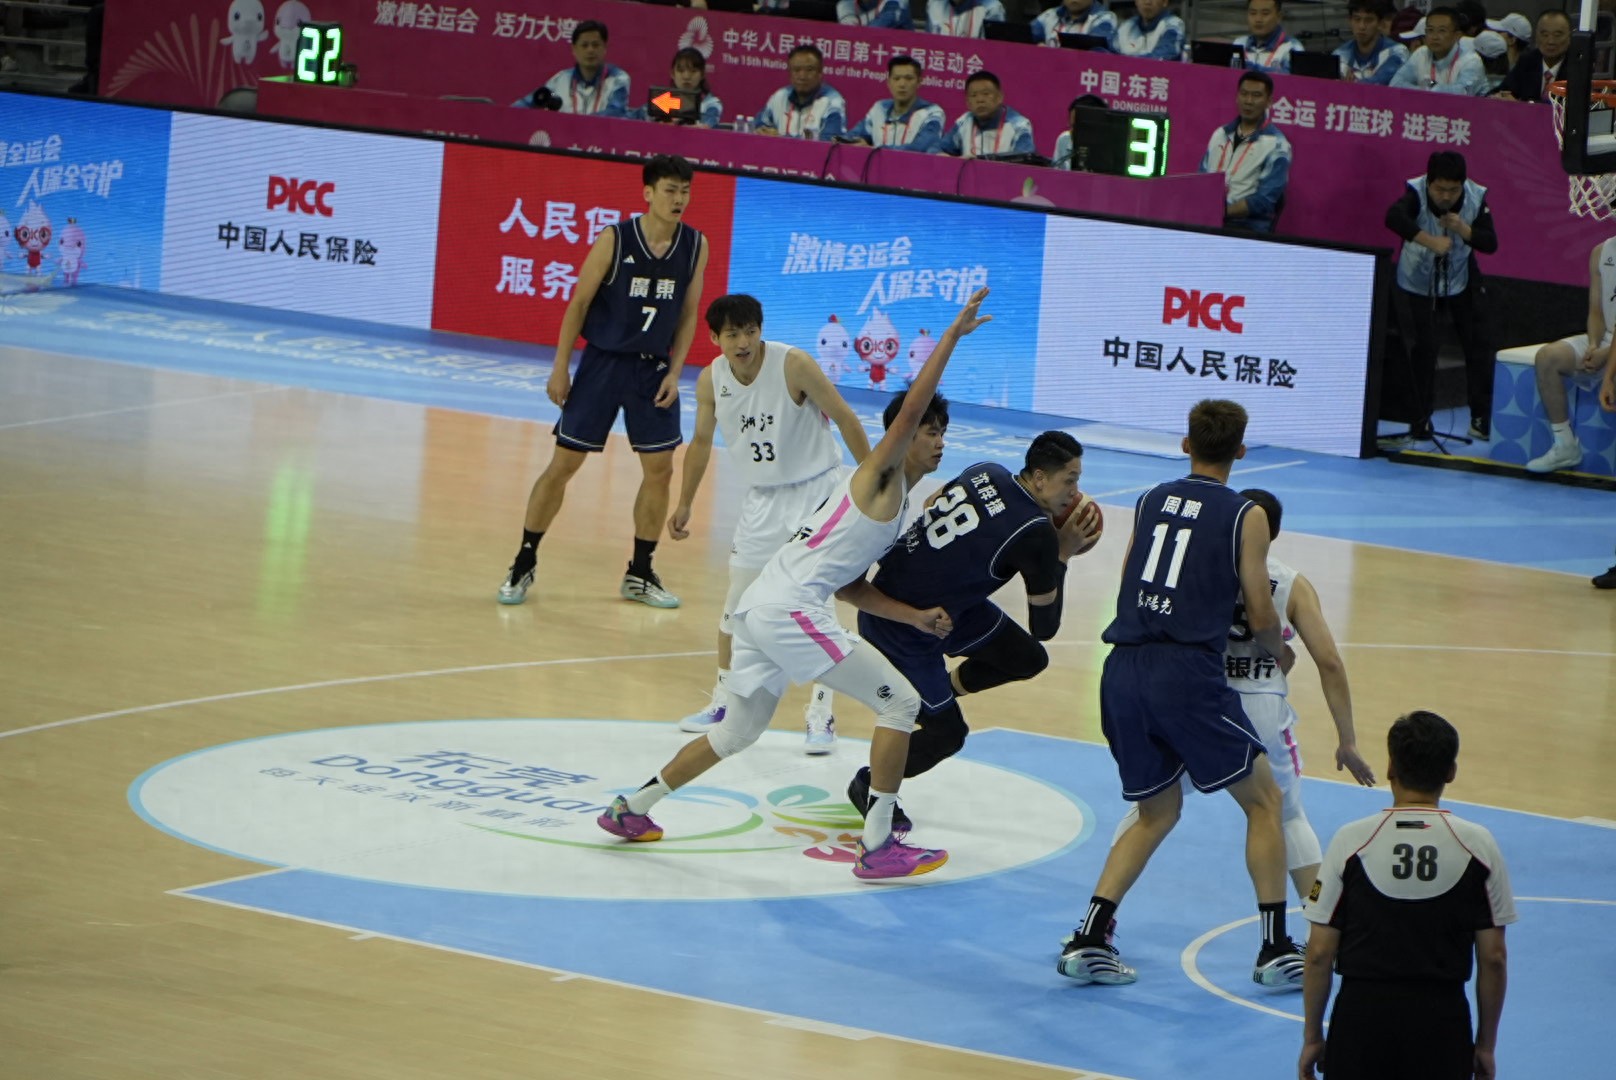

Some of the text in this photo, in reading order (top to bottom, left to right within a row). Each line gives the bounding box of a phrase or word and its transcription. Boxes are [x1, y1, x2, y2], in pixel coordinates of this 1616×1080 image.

[374, 1, 583, 43] 激情全运会 活力大湾
[722, 53, 739, 65] The
[741, 55, 761, 67] 15th
[763, 58, 788, 70] Natio
[835, 66, 846, 75] of
[847, 67, 861, 78] the
[862, 69, 890, 83] Peopl
[944, 78, 955, 88] of
[1080, 68, 1169, 101] 中国·东莞
[1265, 97, 1471, 146] 全运 打篮球 进莞来
[15, 159, 124, 208] 人保全守护
[267, 175, 335, 218] PICC
[499, 197, 645, 245] 人民保
[218, 221, 378, 266] 中国人民保险
[781, 231, 912, 275] 激情全运会
[629, 276, 676, 300] 廣東
[856, 264, 988, 315] 人保全守护
[641, 306, 657, 332] 7
[1162, 286, 1245, 334] PICC
[1103, 336, 1297, 389] 中国人民保险
[751, 442, 775, 462] 33
[924, 484, 980, 550] 28
[1141, 523, 1192, 589] 11
[1226, 655, 1276, 680] 银行
[394, 750, 598, 789] 东莞
[1392, 843, 1438, 882] 38
